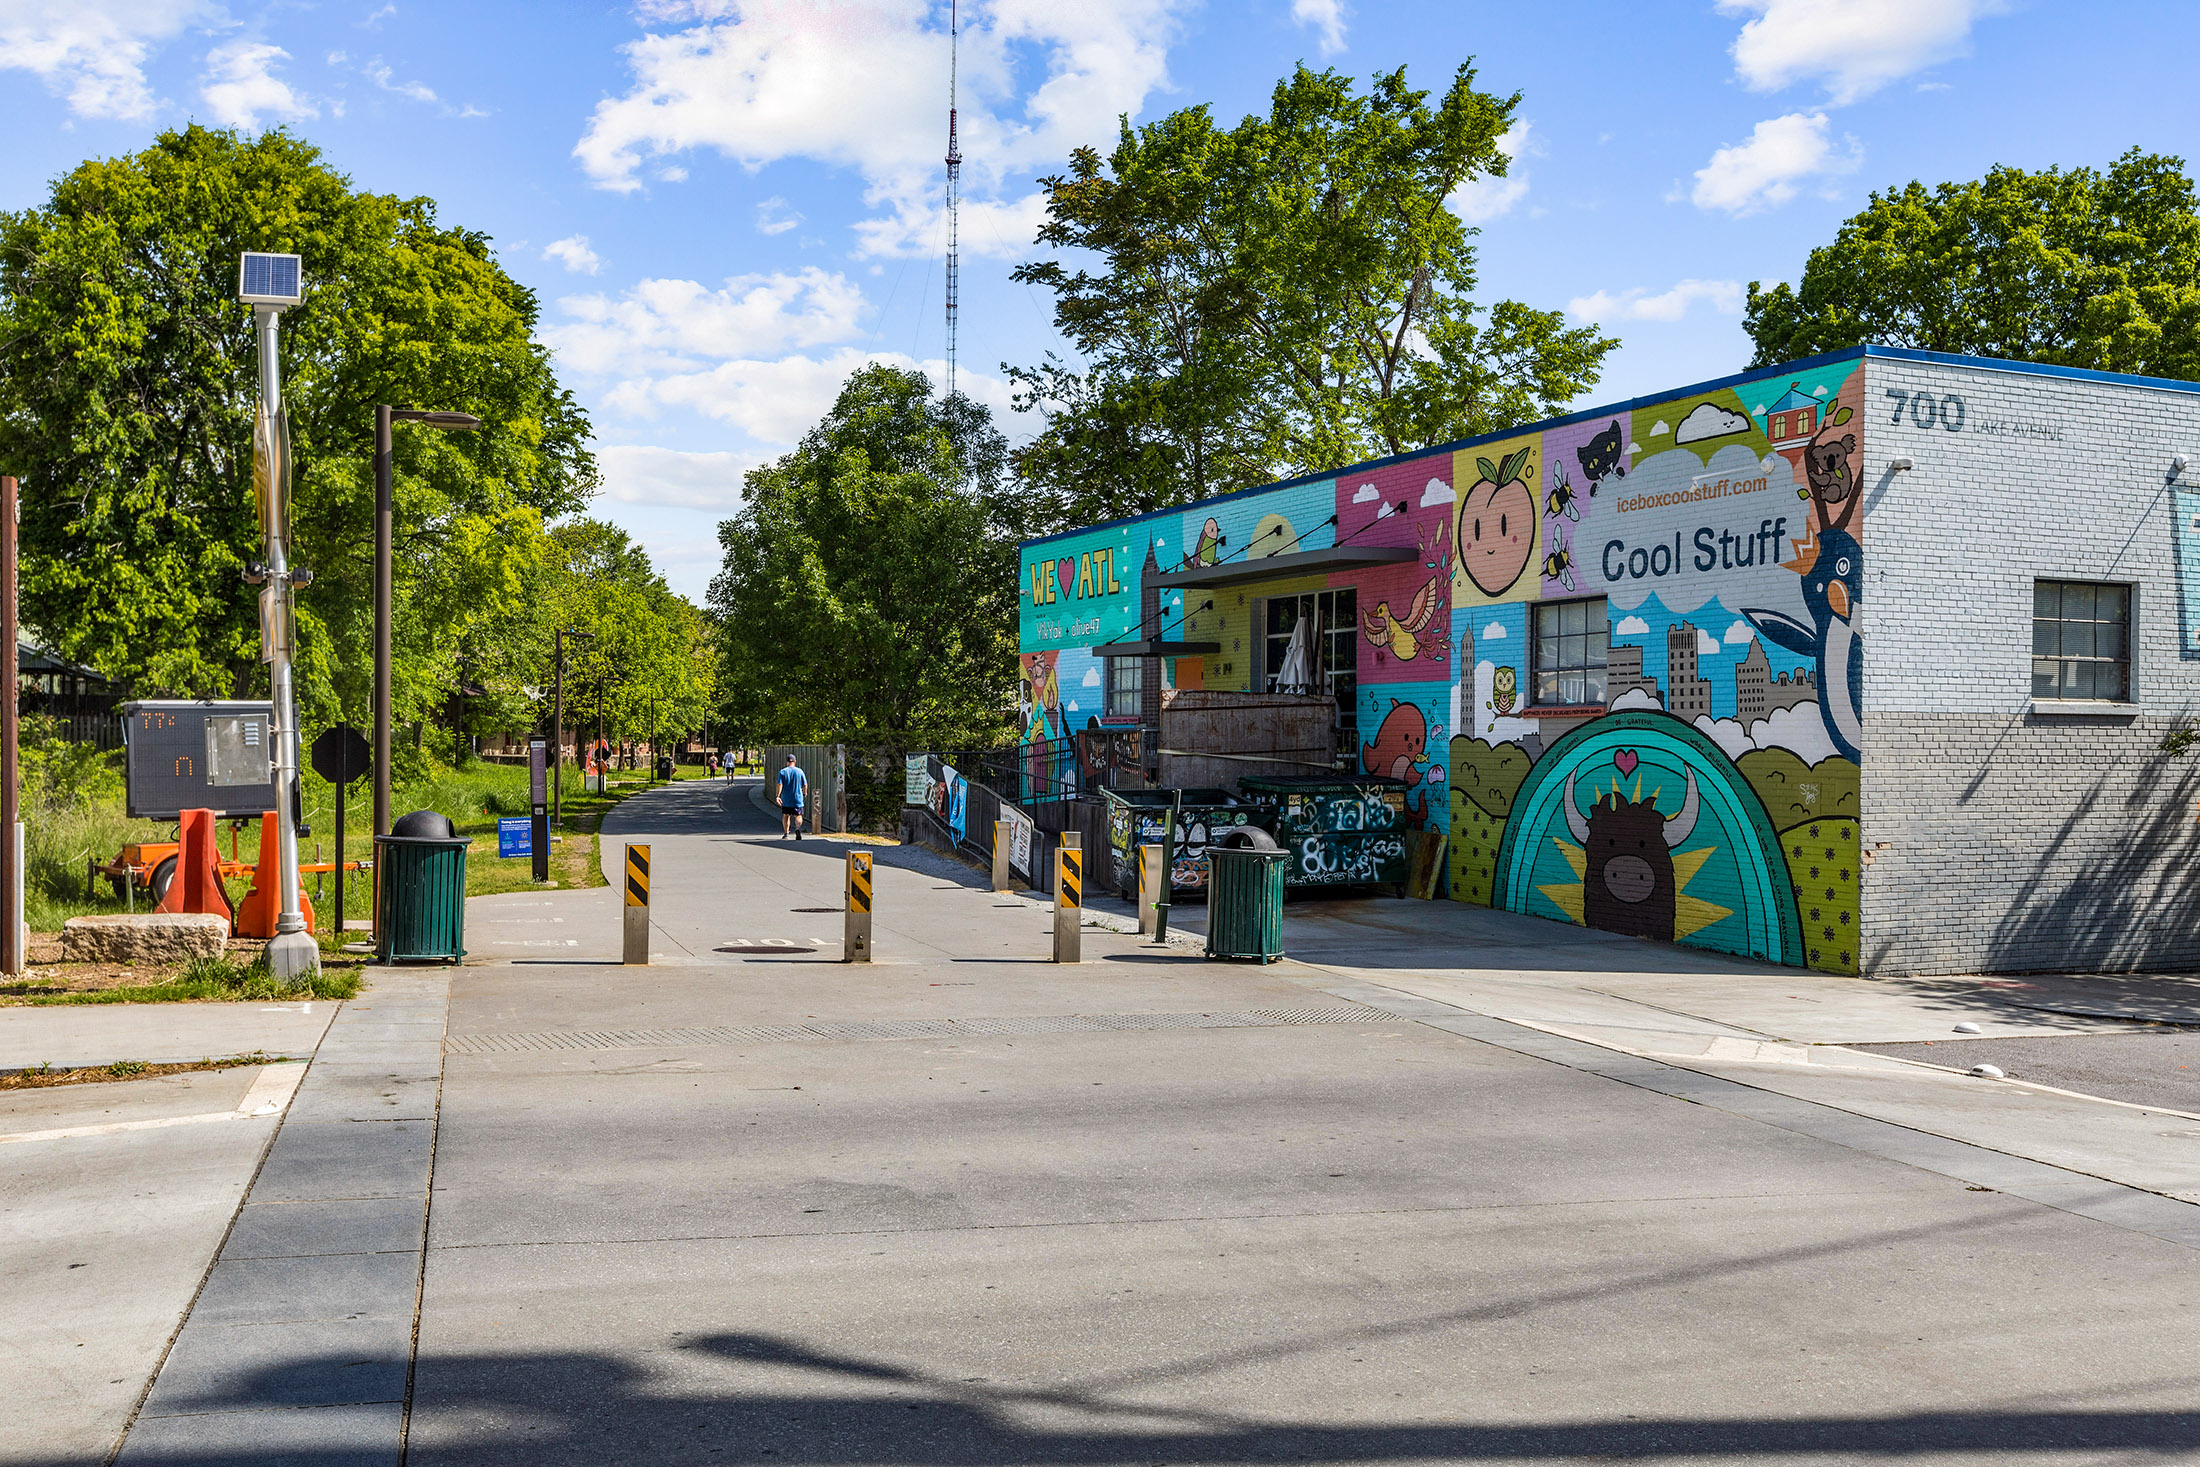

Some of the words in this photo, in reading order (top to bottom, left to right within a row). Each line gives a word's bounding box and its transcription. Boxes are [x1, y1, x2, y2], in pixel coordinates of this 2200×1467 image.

[1885, 388, 1966, 433] 700
[1972, 421, 2008, 437] LAKE
[2011, 422, 2064, 442] AVENUE
[1602, 530, 1681, 582] Cool
[1693, 516, 1787, 573] Stuff
[1030, 559, 1056, 607] WE
[1077, 546, 1120, 600] ATL
[1071, 617, 1101, 638] olive47
[1708, 752, 1732, 777] DILIGENTLY
